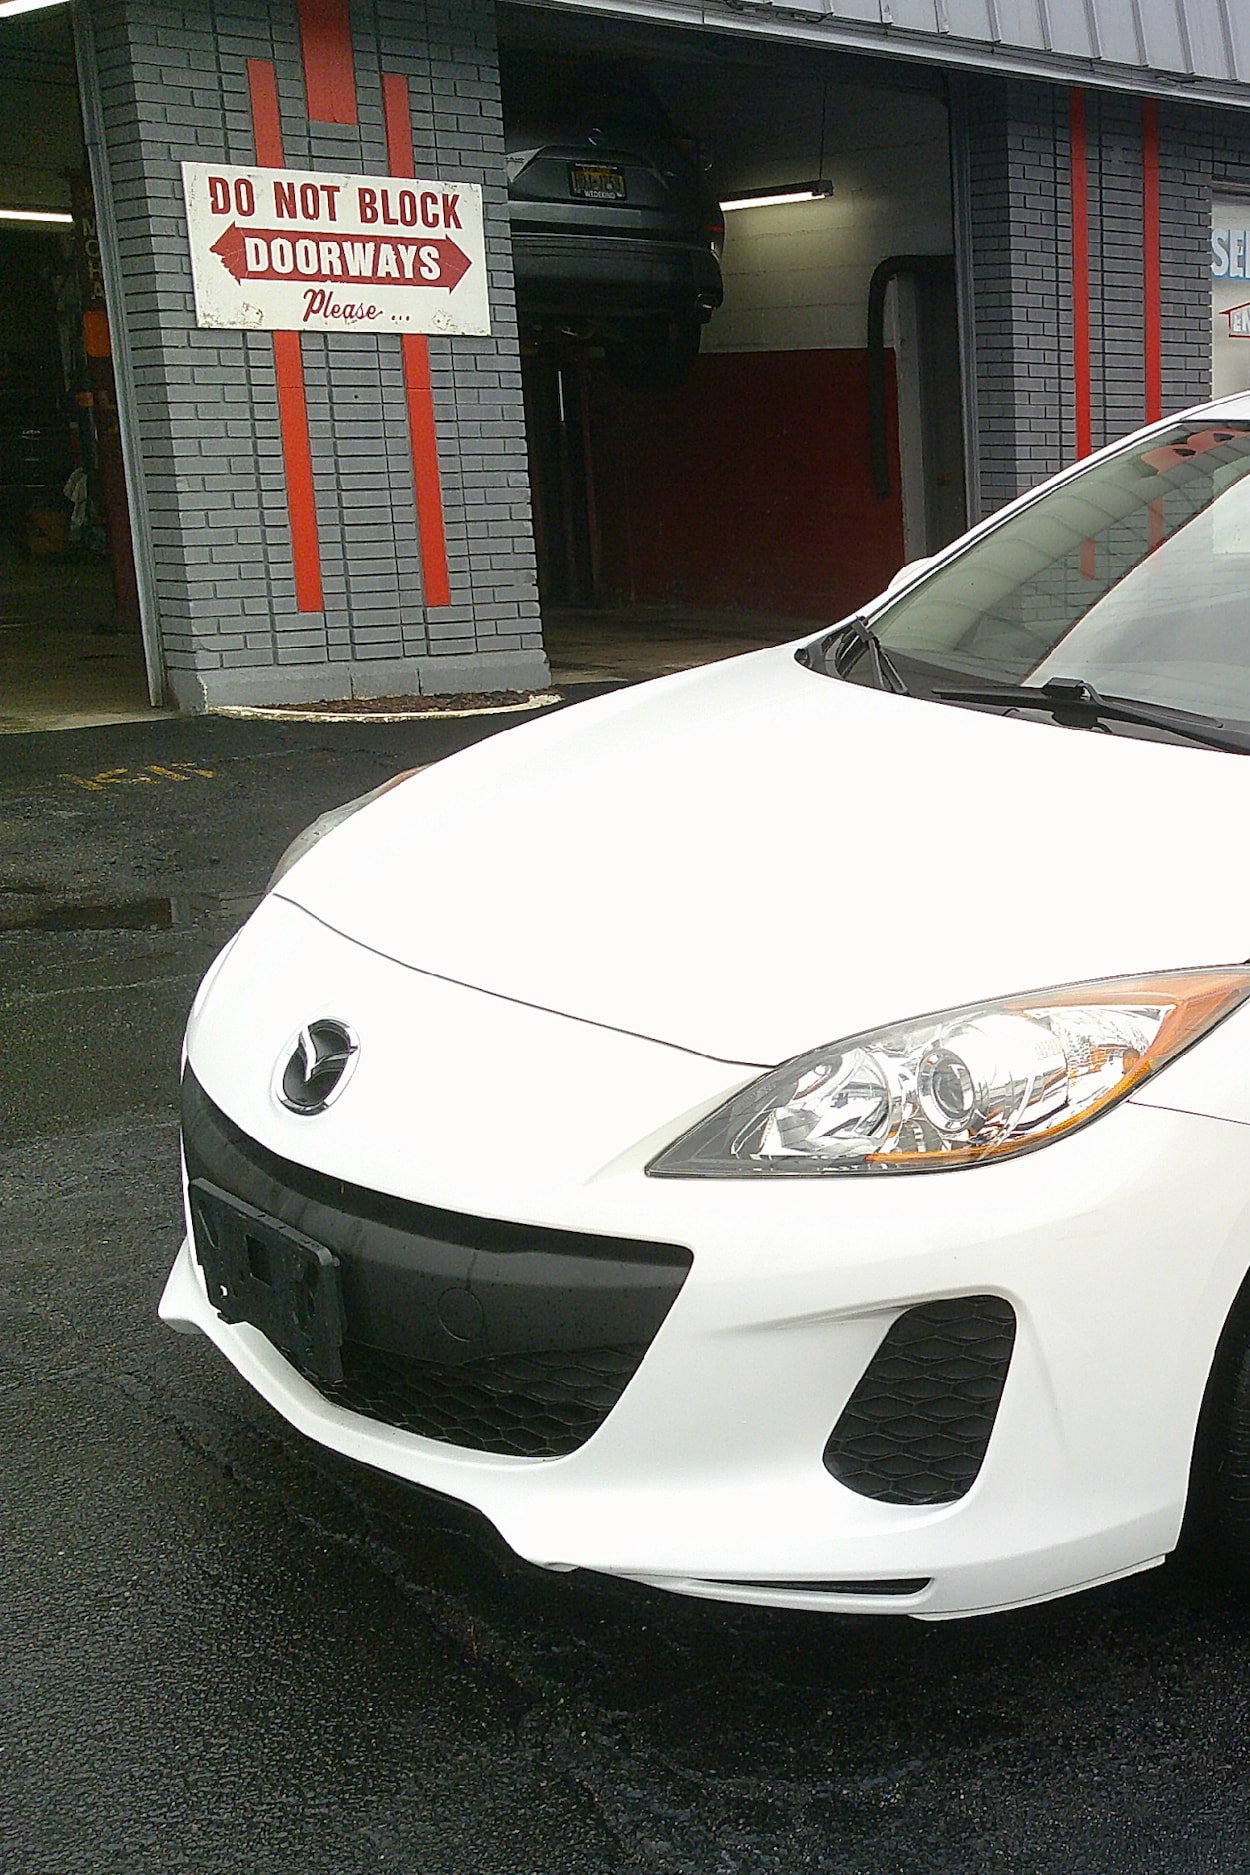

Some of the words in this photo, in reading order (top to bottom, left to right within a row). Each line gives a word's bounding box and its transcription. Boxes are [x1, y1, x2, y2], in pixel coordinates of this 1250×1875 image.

[208, 176, 255, 216] DO
[273, 181, 340, 221] NOT
[358, 187, 463, 229] BLOCK
[245, 237, 441, 281] DOORWAYS
[303, 288, 383, 322] Please
